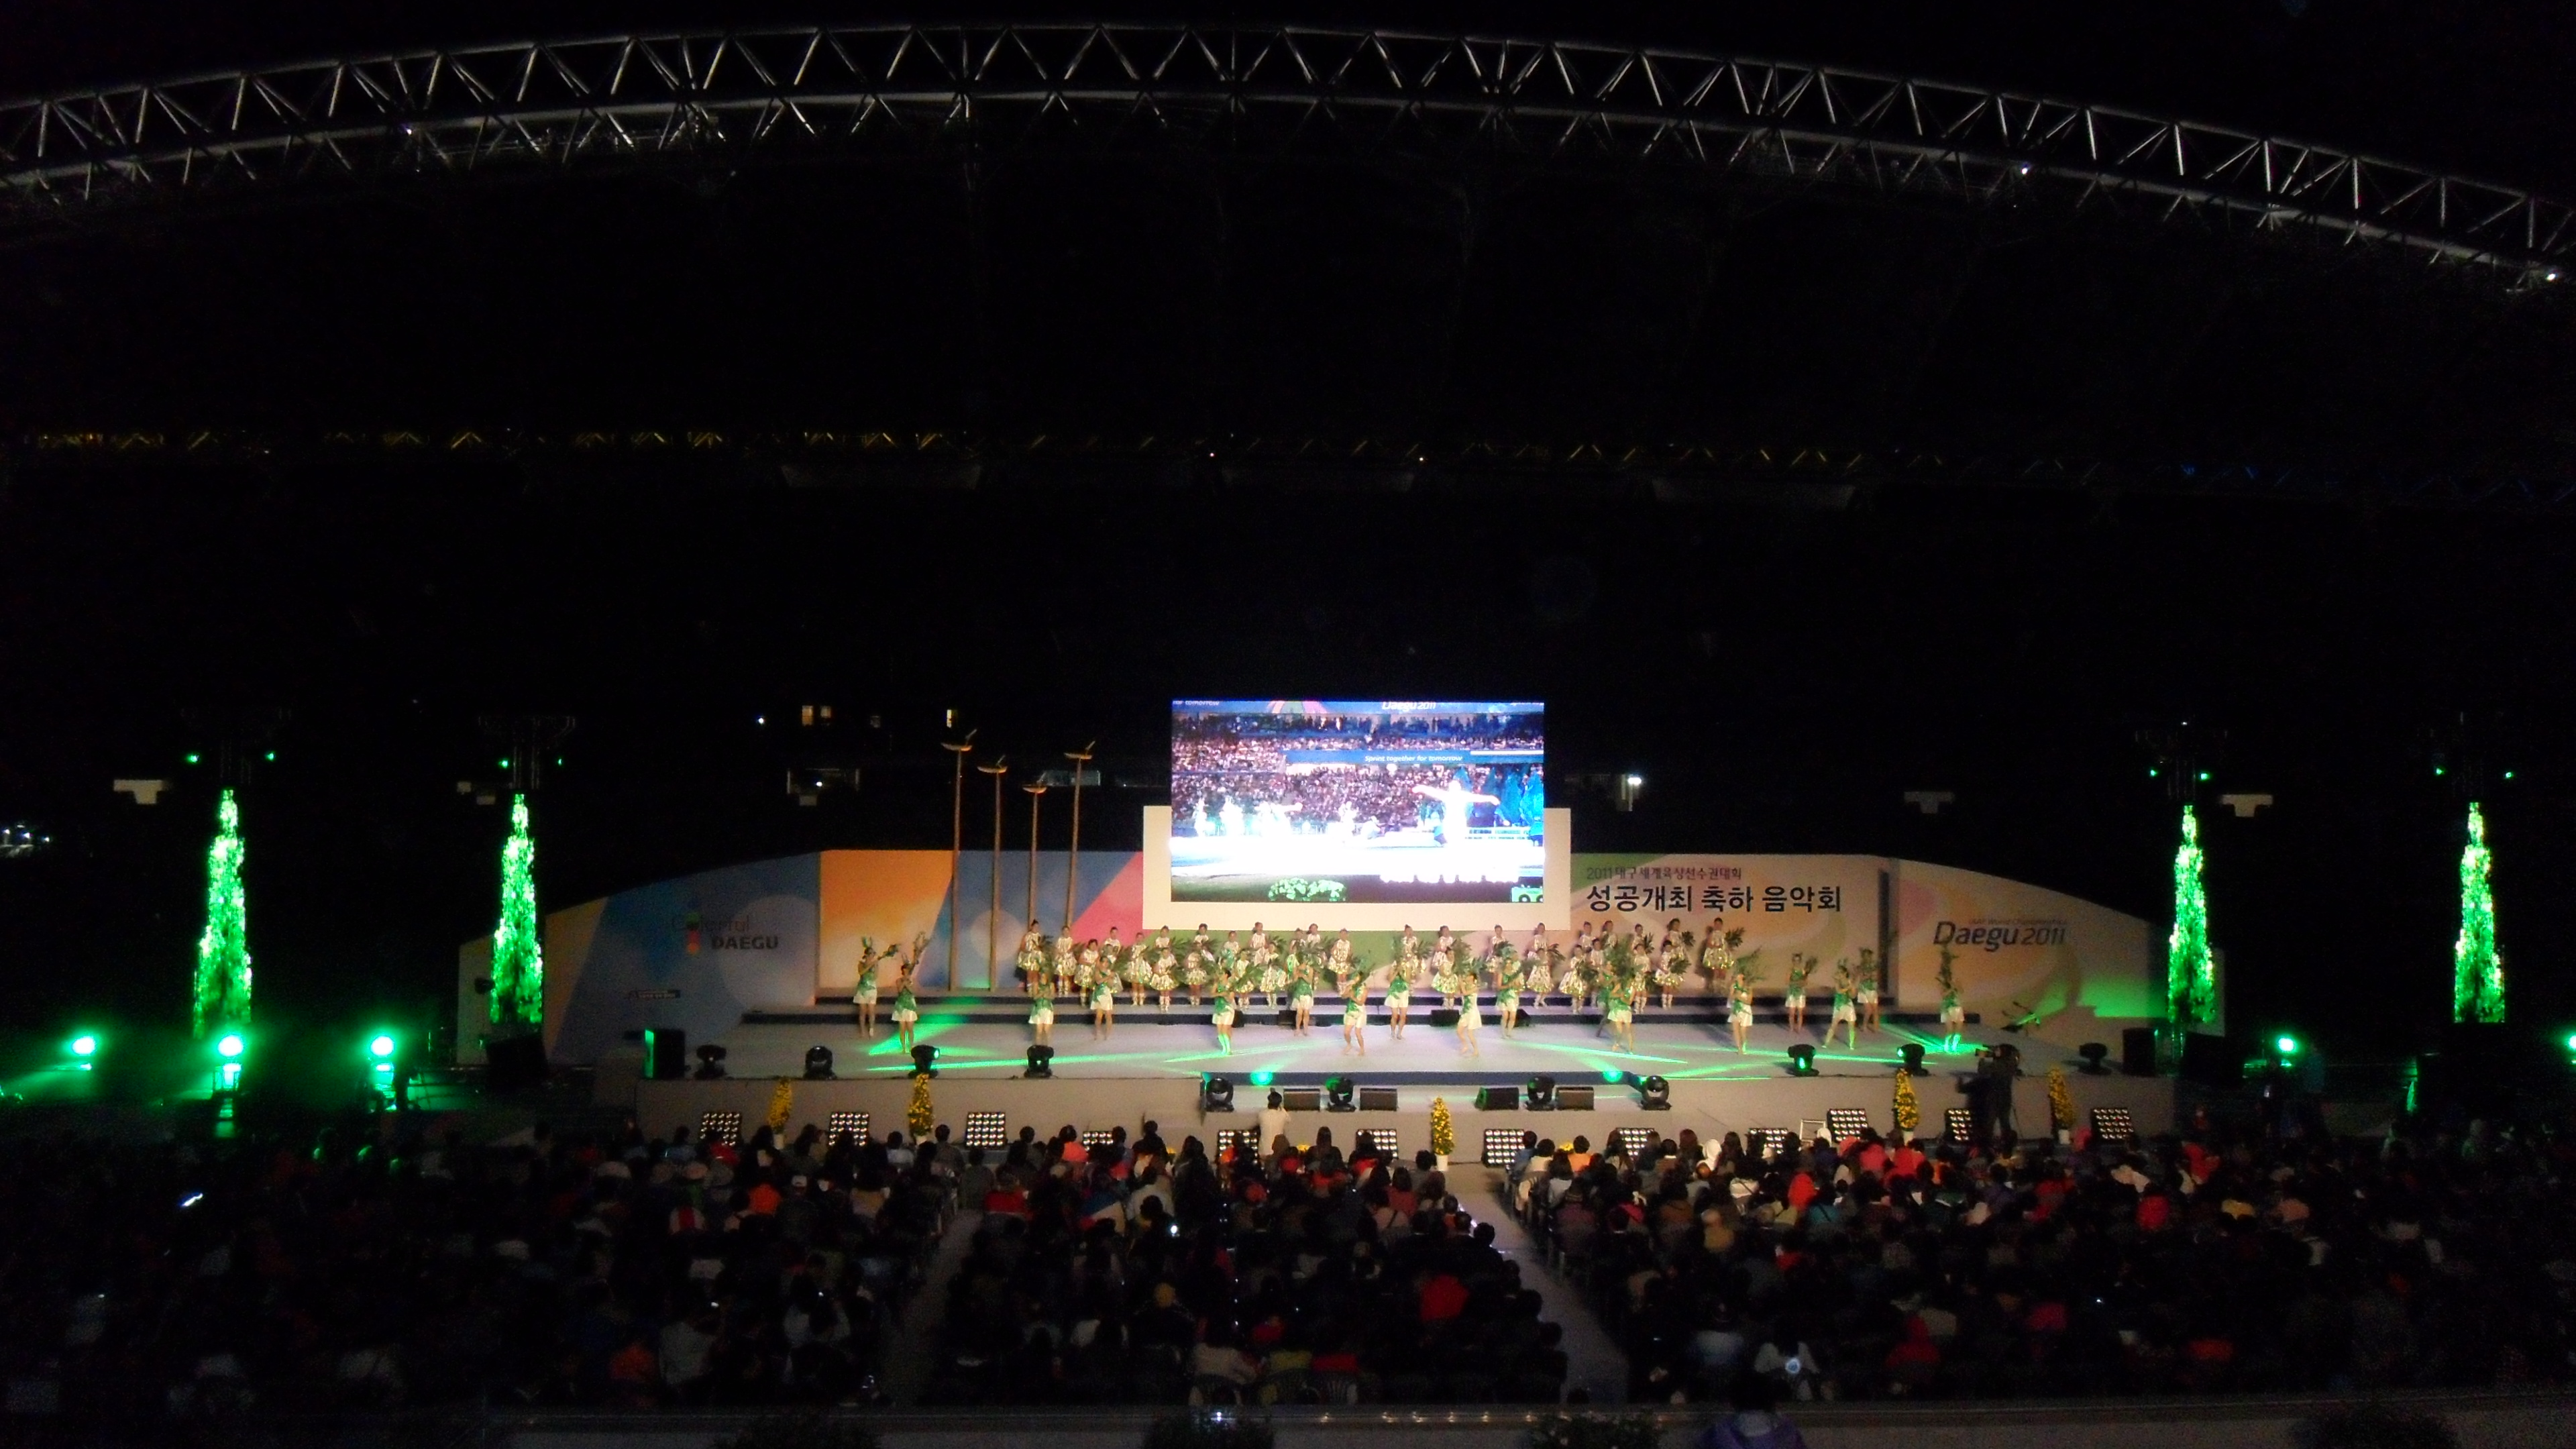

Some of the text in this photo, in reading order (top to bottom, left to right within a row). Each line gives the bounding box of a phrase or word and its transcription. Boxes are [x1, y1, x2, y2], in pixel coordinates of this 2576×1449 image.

[1586, 885, 1842, 913] 성공개최 축하 음악회
[711, 935, 779, 950] DAEGU
